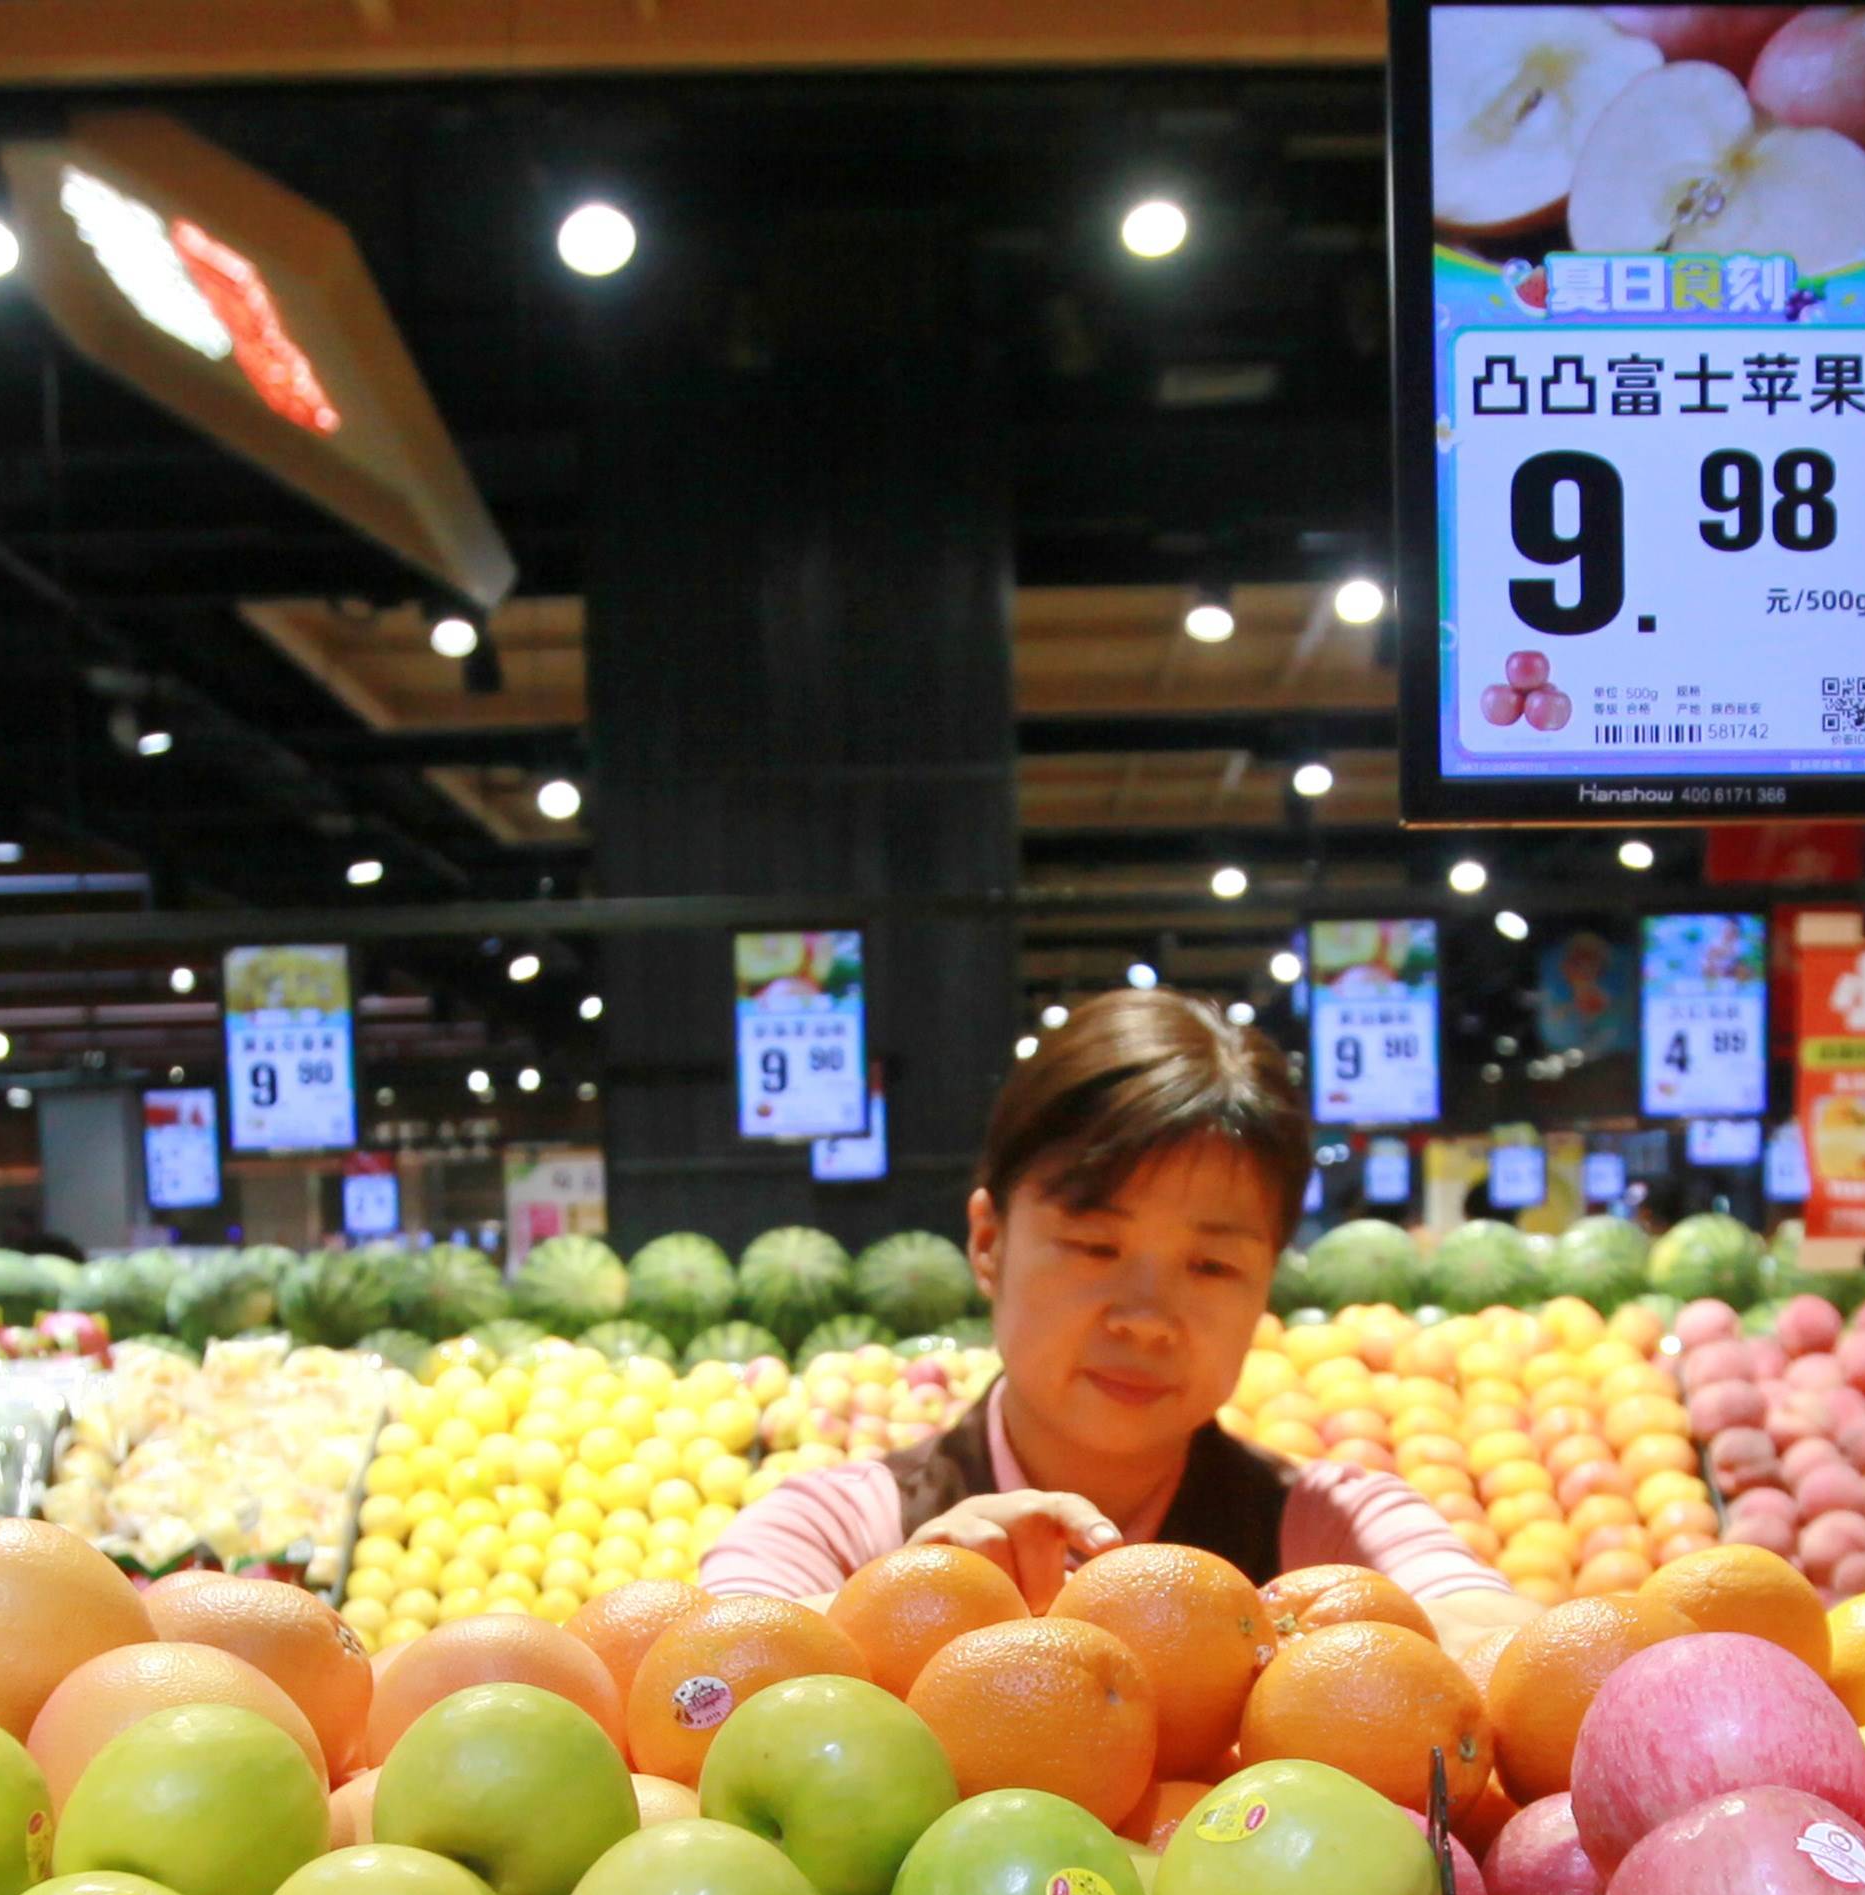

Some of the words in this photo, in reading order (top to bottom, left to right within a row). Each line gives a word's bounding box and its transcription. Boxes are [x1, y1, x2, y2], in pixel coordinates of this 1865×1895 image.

[1547, 255, 1792, 315] 夏日食刻
[1699, 447, 1838, 553] 98
[1707, 723, 1769, 740] 581742
[1579, 784, 1673, 804] Hanshow
[1681, 787, 1711, 803] 400
[1714, 786, 1754, 802] 6171
[250, 1062, 278, 1107] 9
[761, 1049, 789, 1092] 9
